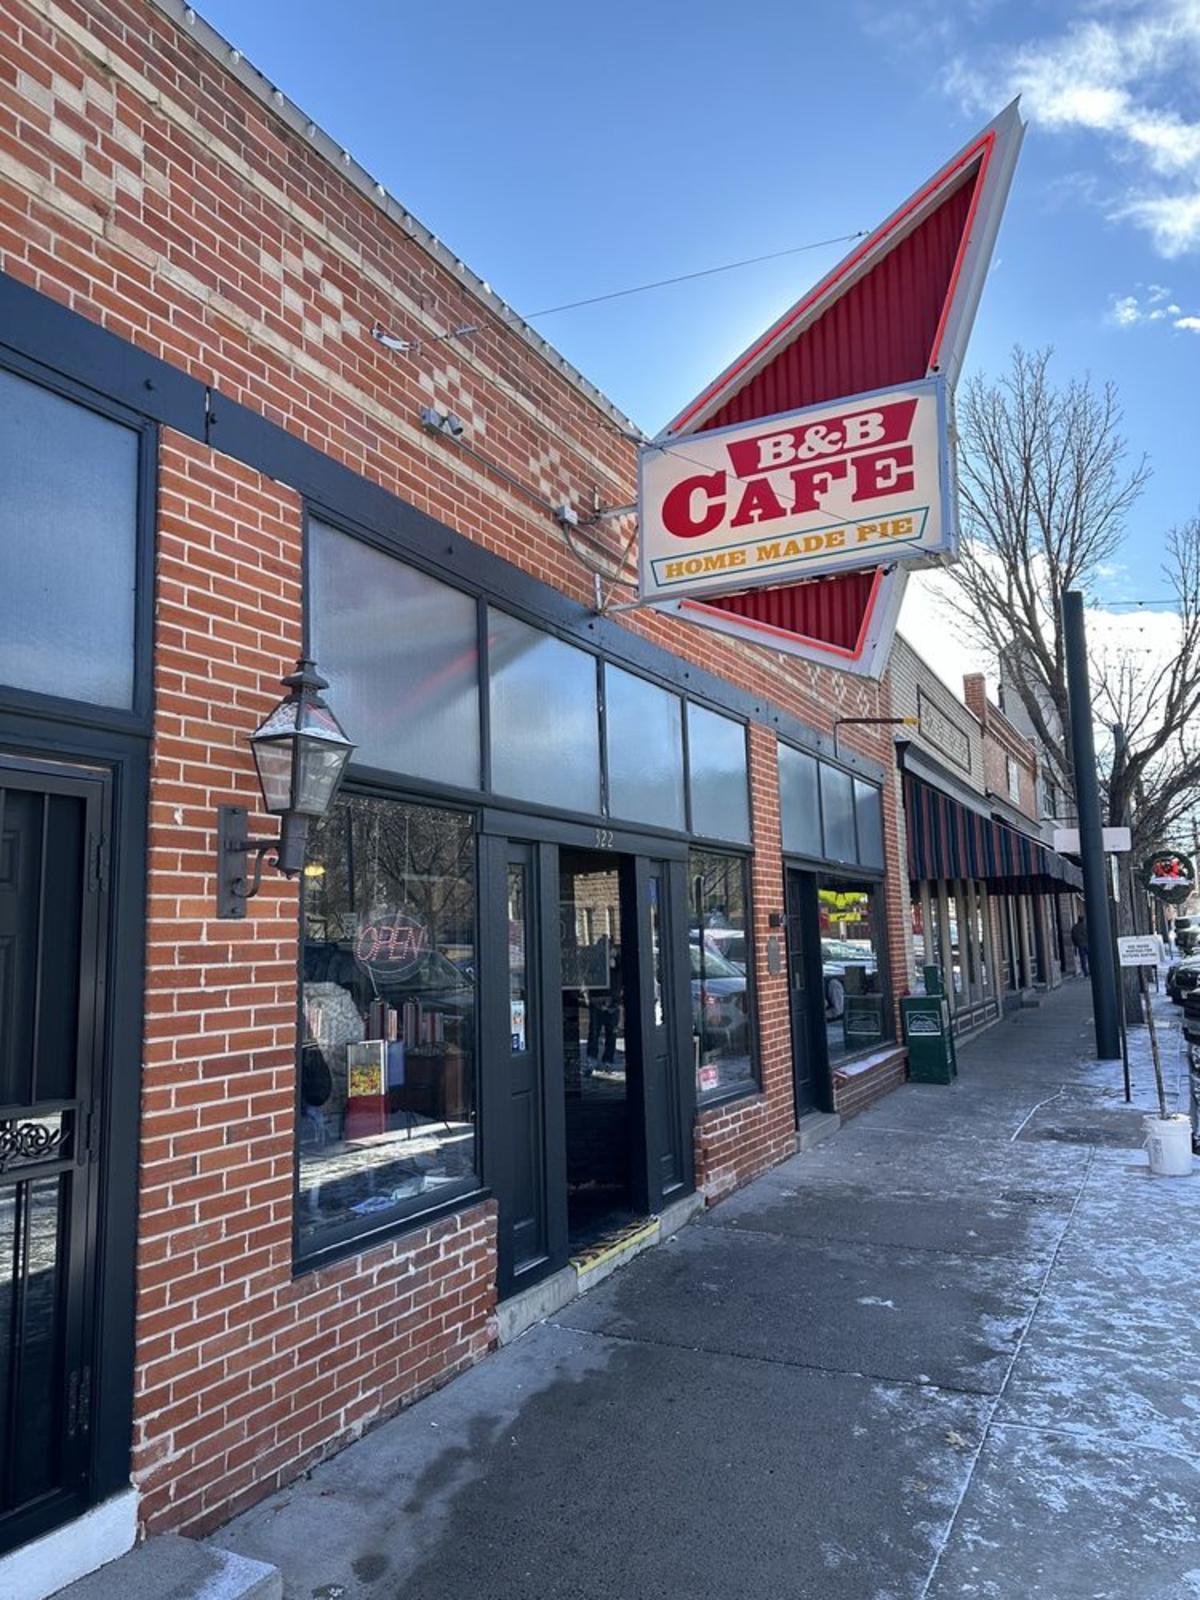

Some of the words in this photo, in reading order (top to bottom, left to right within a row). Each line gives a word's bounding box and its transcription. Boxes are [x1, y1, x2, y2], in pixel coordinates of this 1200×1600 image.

[757, 411, 886, 469] B&B
[661, 445, 914, 538] CAFE
[665, 549, 746, 579] HOME
[756, 530, 845, 561] MADE
[856, 516, 913, 543] PIE
[356, 925, 425, 961] OPEN
